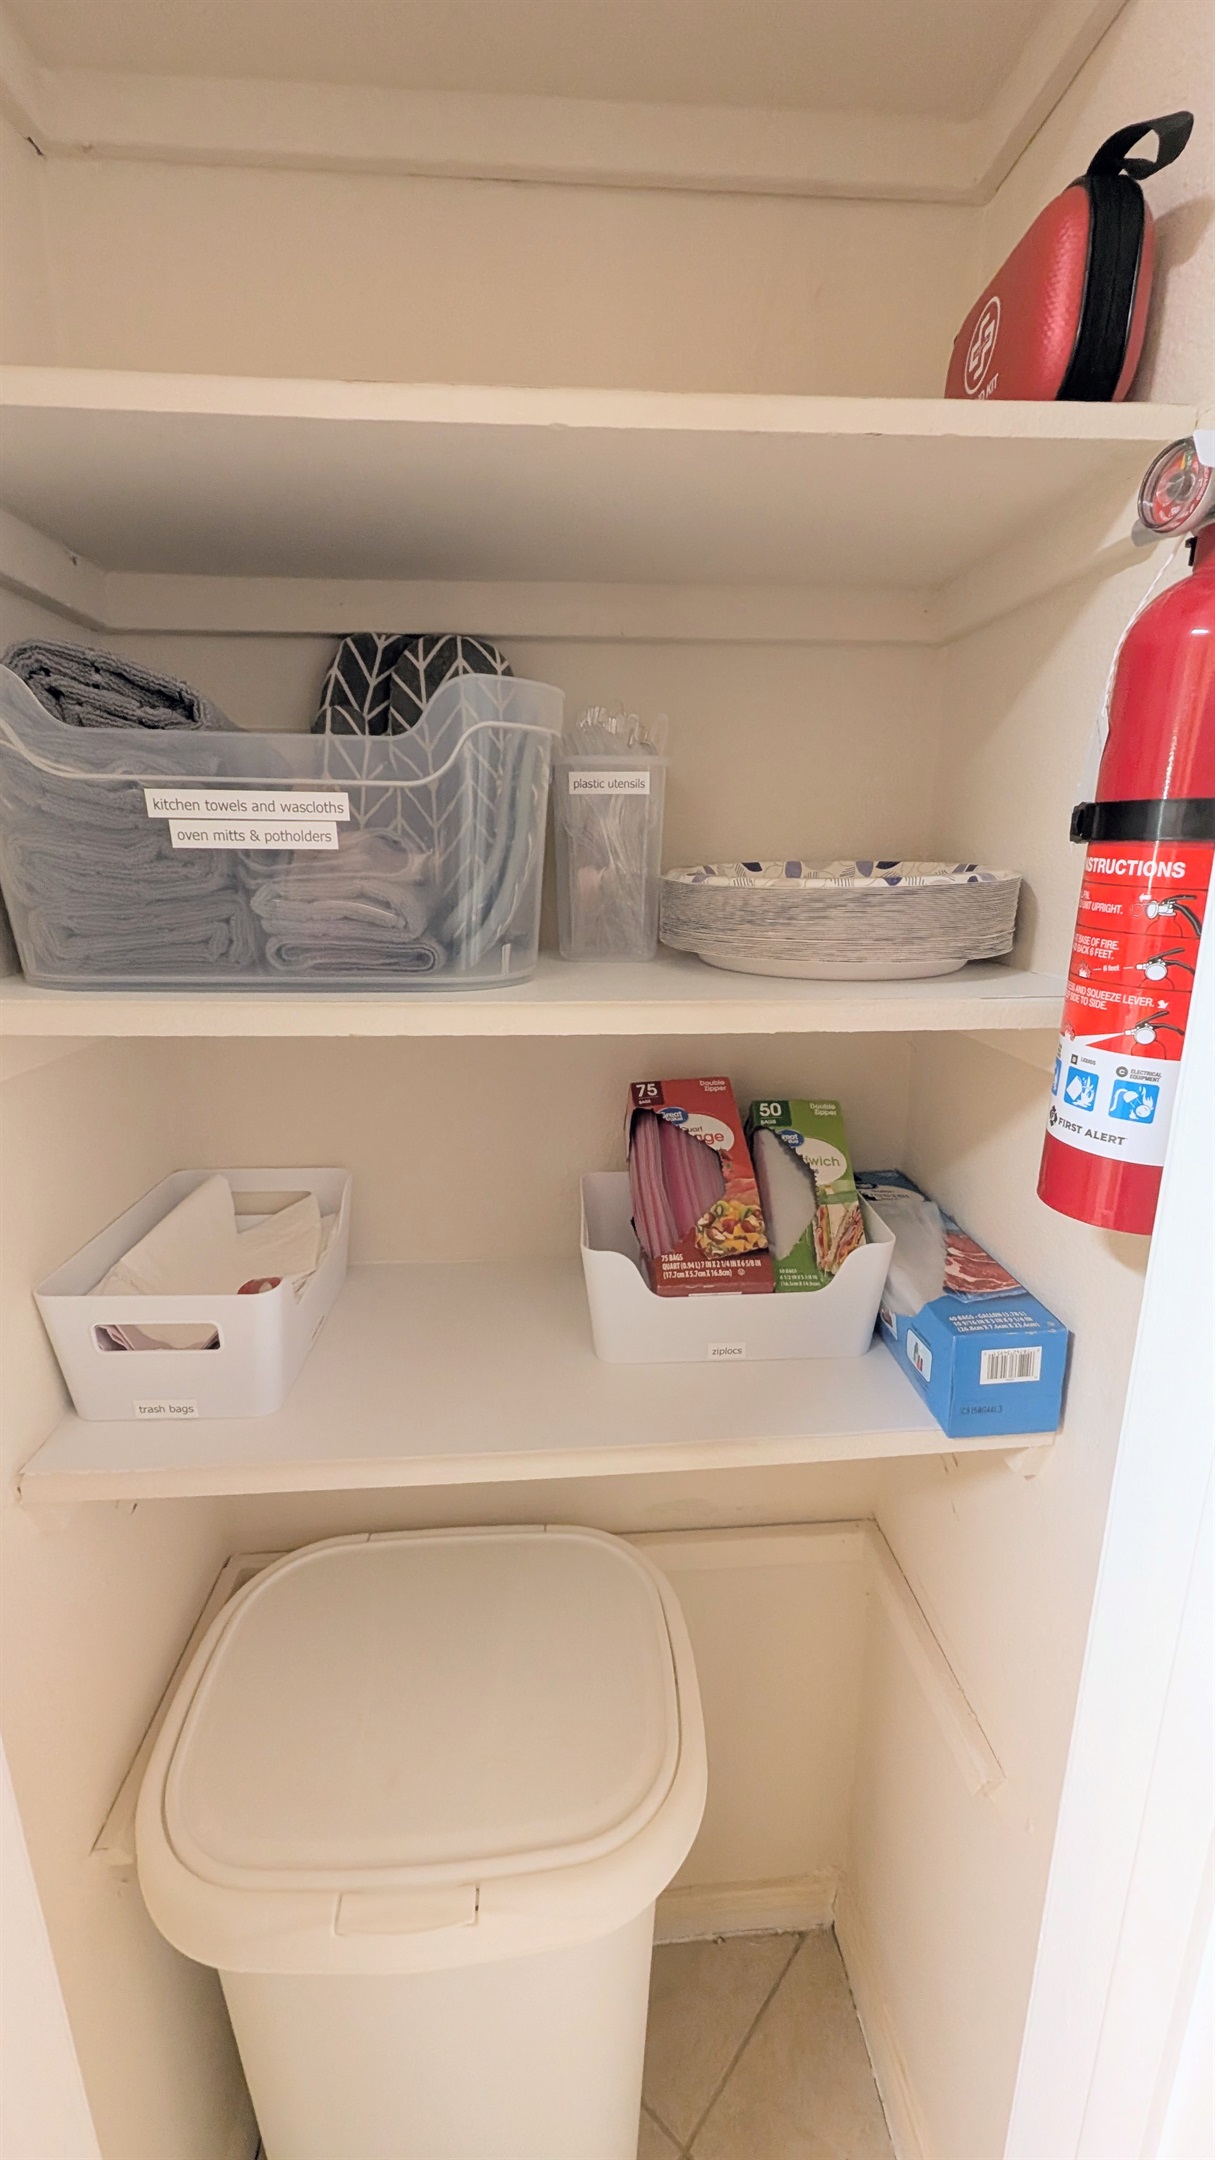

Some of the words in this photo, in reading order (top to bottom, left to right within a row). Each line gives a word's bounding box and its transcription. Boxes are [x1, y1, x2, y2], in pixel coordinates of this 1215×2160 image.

[986, 373, 998, 398] KIT
[573, 778, 605, 790] plastic
[608, 778, 646, 789] utensils
[152, 798, 200, 811] kitchen
[205, 799, 247, 812] towels
[252, 800, 275, 813] and
[280, 801, 344, 814] wascloths
[177, 831, 208, 841] oven
[213, 829, 245, 841] mitts
[250, 830, 260, 841] &
[264, 830, 332, 844] potholders
[1091, 903, 1123, 914] UPRIGHT.
[1091, 937, 1100, 947] OF
[1100, 939, 1119, 950] FIRE.
[1090, 948, 1094, 956] 6
[1094, 948, 1114, 960] FEET.
[1070, 994, 1080, 1003] SIDE
[1080, 996, 1089, 1006] TO
[1088, 998, 1107, 1011] SIDE.
[1075, 985, 1086, 995] AND
[1086, 987, 1122, 1003] SQUEEZE
[1122, 994, 1155, 1008] LEVER.
[1129, 1074, 1160, 1083] EQUIPMENT
[1130, 1068, 1162, 1078] ELECTRICAL
[636, 1083, 658, 1097] 75
[704, 1085, 727, 1093] Zipper
[759, 1103, 782, 1117] 50
[1058, 1117, 1082, 1134] FIRST
[1084, 1129, 1126, 1146] ALERT
[669, 1253, 684, 1261] BAGS
[662, 1262, 680, 1271] QUART
[681, 1261, 695, 1270] (0.94
[695, 1261, 701, 1270] L)
[663, 1271, 684, 1280] (17.7cm
[690, 1270, 706, 1278] 5.7cm
[711, 1269, 732, 1278] 16.8cm)
[712, 1347, 743, 1357] ziplocs
[139, 1404, 166, 1414] trash
[169, 1404, 195, 1415] bags
